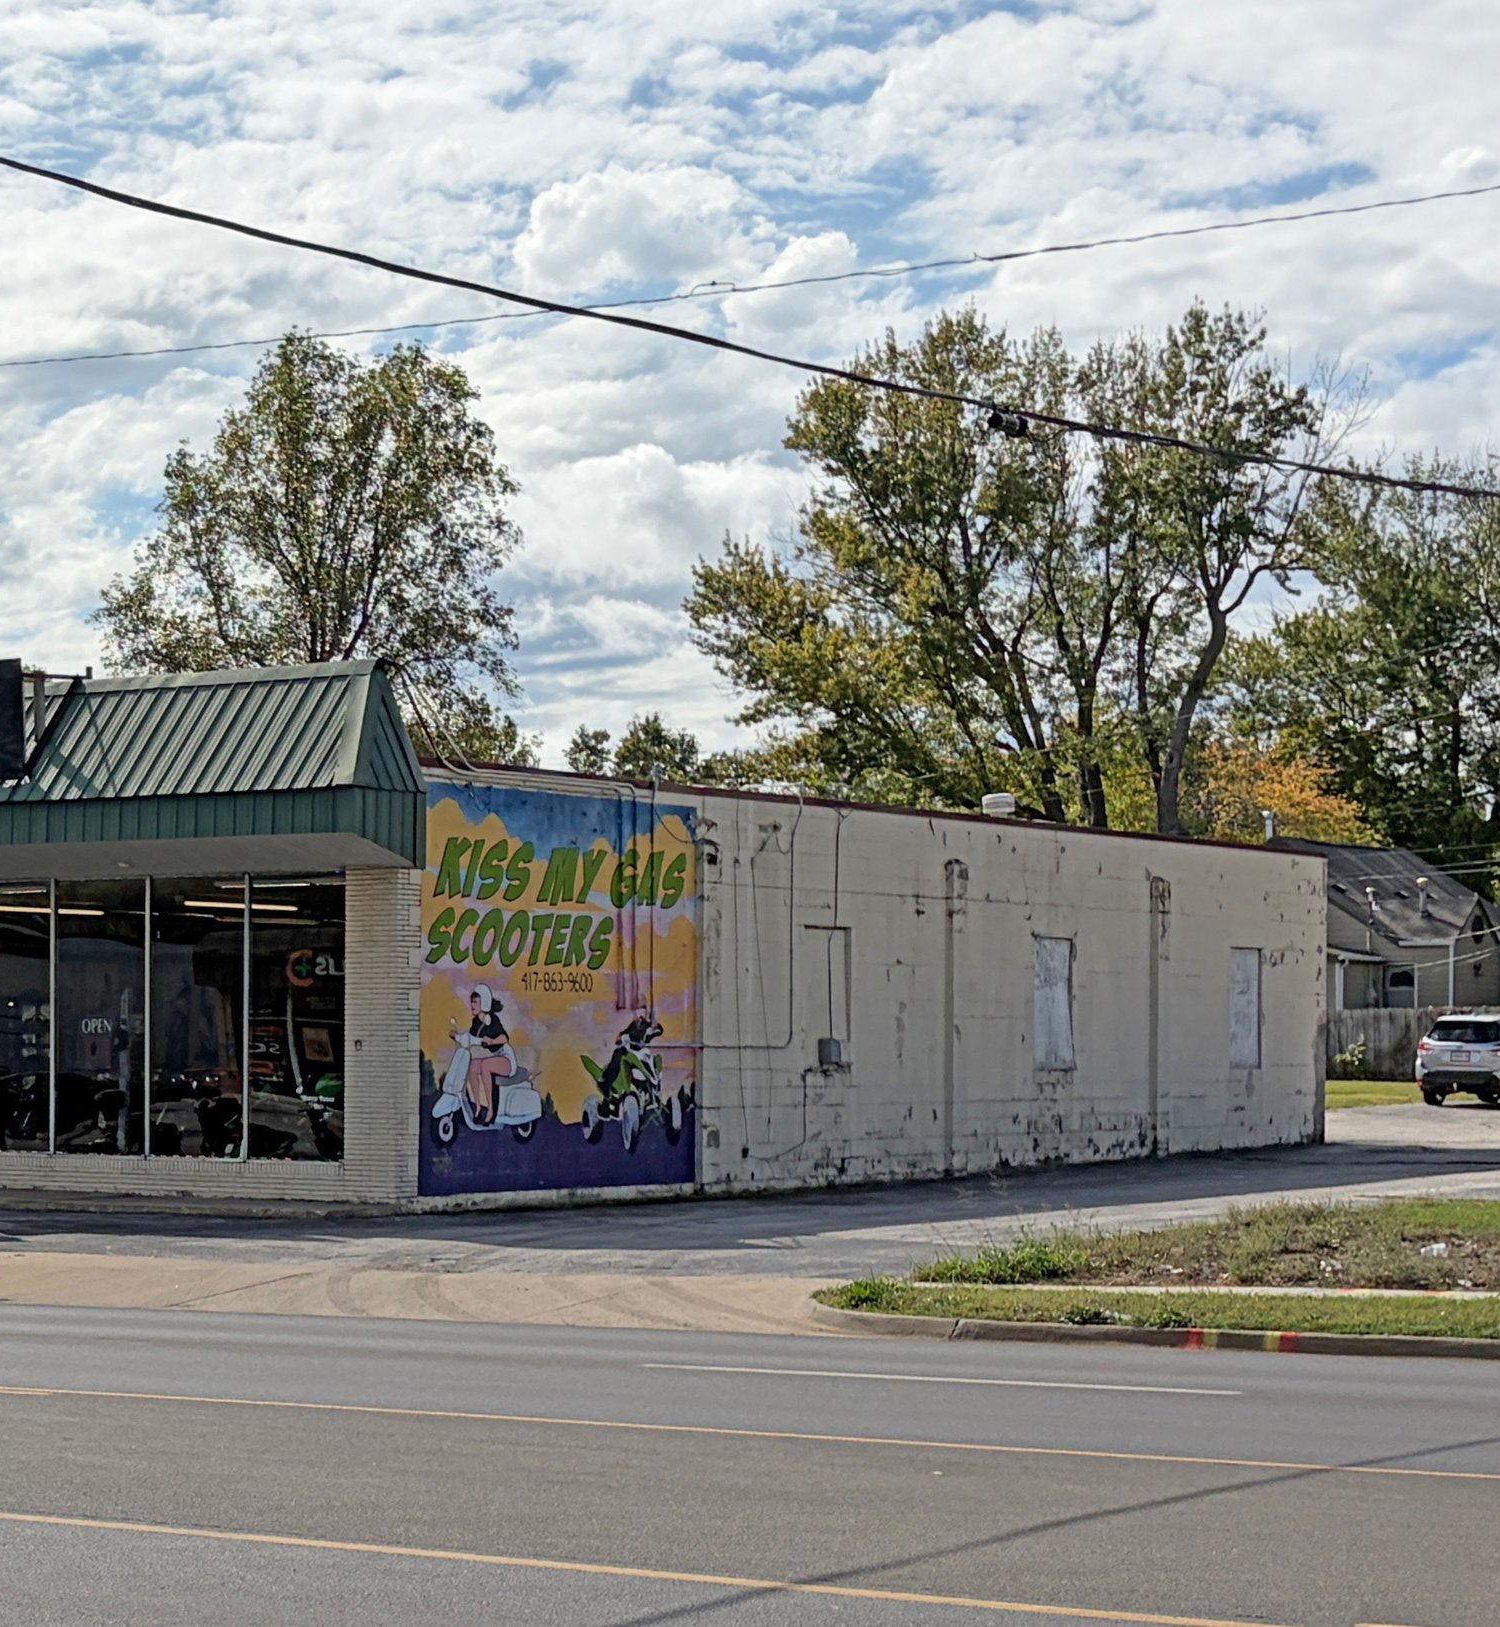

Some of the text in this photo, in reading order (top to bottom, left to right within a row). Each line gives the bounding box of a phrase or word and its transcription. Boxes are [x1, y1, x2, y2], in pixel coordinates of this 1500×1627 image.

[433, 837, 687, 909] KISS MY GAS
[425, 907, 614, 970] SCOOTERS
[521, 972, 594, 993] 417-863-9600
[81, 1018, 112, 1034] OPEN
